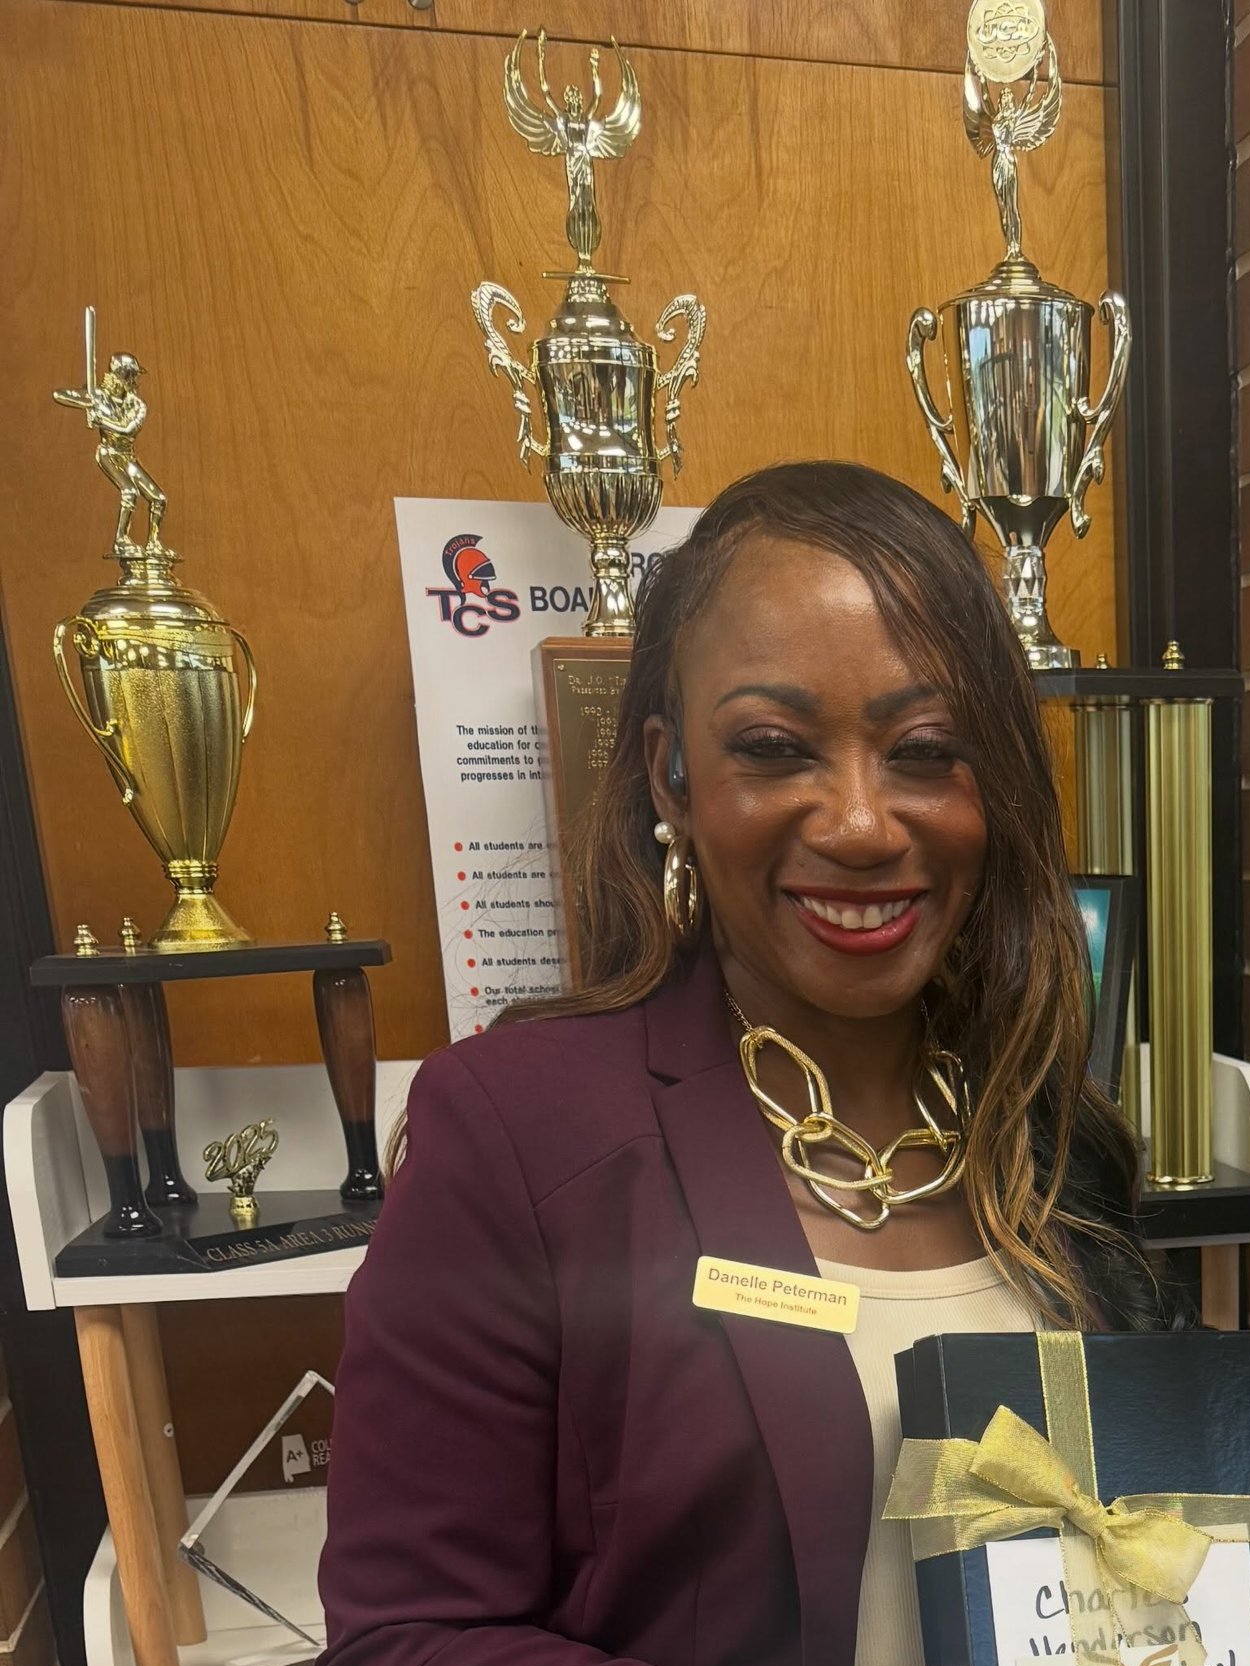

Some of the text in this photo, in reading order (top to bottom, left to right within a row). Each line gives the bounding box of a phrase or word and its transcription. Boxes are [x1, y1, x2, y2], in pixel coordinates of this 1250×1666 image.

[446, 538, 477, 556] Trojans
[426, 586, 594, 637] TCS BOA
[456, 725, 474, 736] The
[478, 725, 514, 736] mission
[517, 725, 528, 736] of
[467, 740, 514, 750] education
[517, 740, 531, 750] for
[457, 755, 520, 766] commitments
[524, 755, 534, 765] to
[461, 771, 514, 782] progresses
[517, 770, 526, 780] in
[469, 842, 480, 851] All
[484, 842, 524, 851] students
[528, 842, 543, 850] are
[472, 871, 483, 880] All
[487, 871, 527, 880] students
[475, 901, 487, 910] All
[490, 900, 530, 909] students
[478, 929, 495, 938] The
[499, 928, 544, 938] education
[482, 958, 493, 967] All
[497, 957, 536, 966] students
[485, 985, 500, 995] Our
[486, 997, 508, 1006] each
[203, 1117, 280, 1182] 2025
[206, 1219, 377, 1263] CLASS 5A AREA 3 RUNN
[708, 1267, 847, 1306] Danelle Peterman
[735, 1292, 817, 1316] The Hope Institute
[286, 1449, 304, 1463] A+
